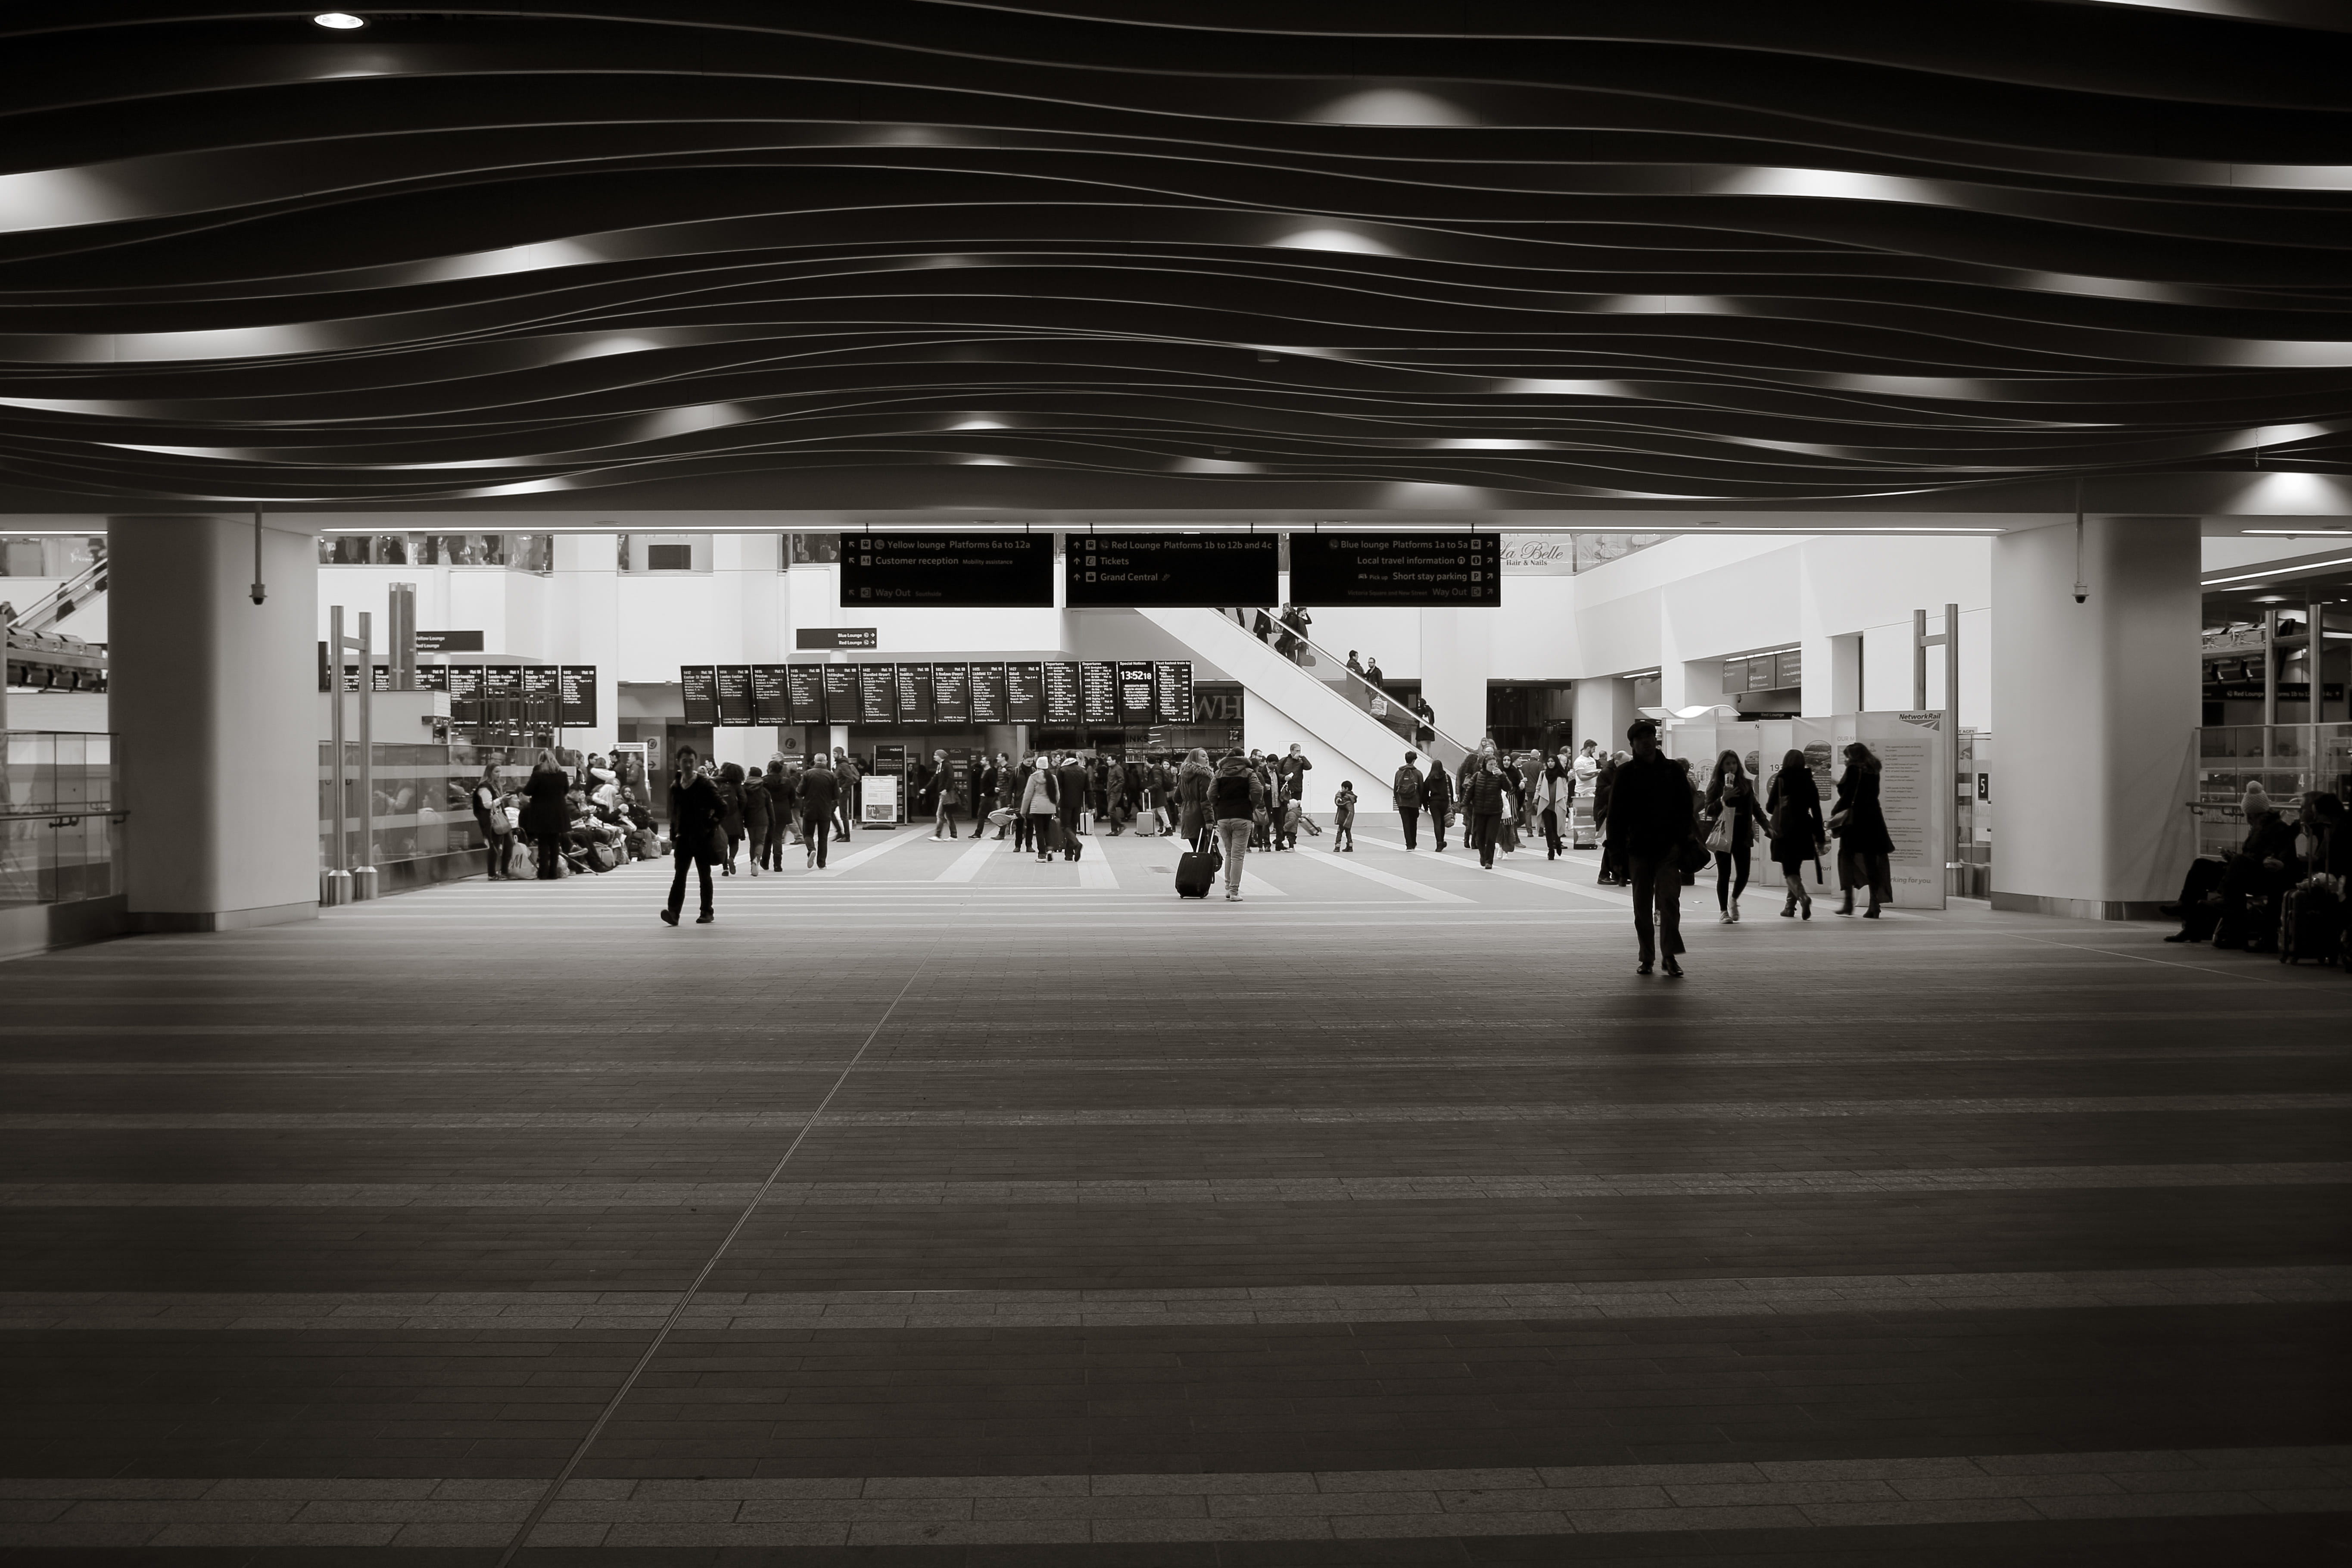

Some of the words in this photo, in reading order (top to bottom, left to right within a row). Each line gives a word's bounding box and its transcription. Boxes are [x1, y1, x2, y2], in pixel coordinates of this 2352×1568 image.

[917, 541, 945, 550] lounge
[1130, 541, 1160, 550] Lounge
[1361, 540, 1389, 550] lounge
[1520, 540, 1564, 560] Belle
[919, 556, 958, 566] reception
[1100, 557, 1129, 565] Tickets
[1417, 573, 1434, 581] stay
[1437, 572, 1467, 581] parking
[875, 589, 893, 598] Way
[1432, 588, 1450, 597] Way
[1452, 588, 1467, 596] Out
[2298, 774, 2305, 787] 4
[1981, 778, 1985, 793] 5
